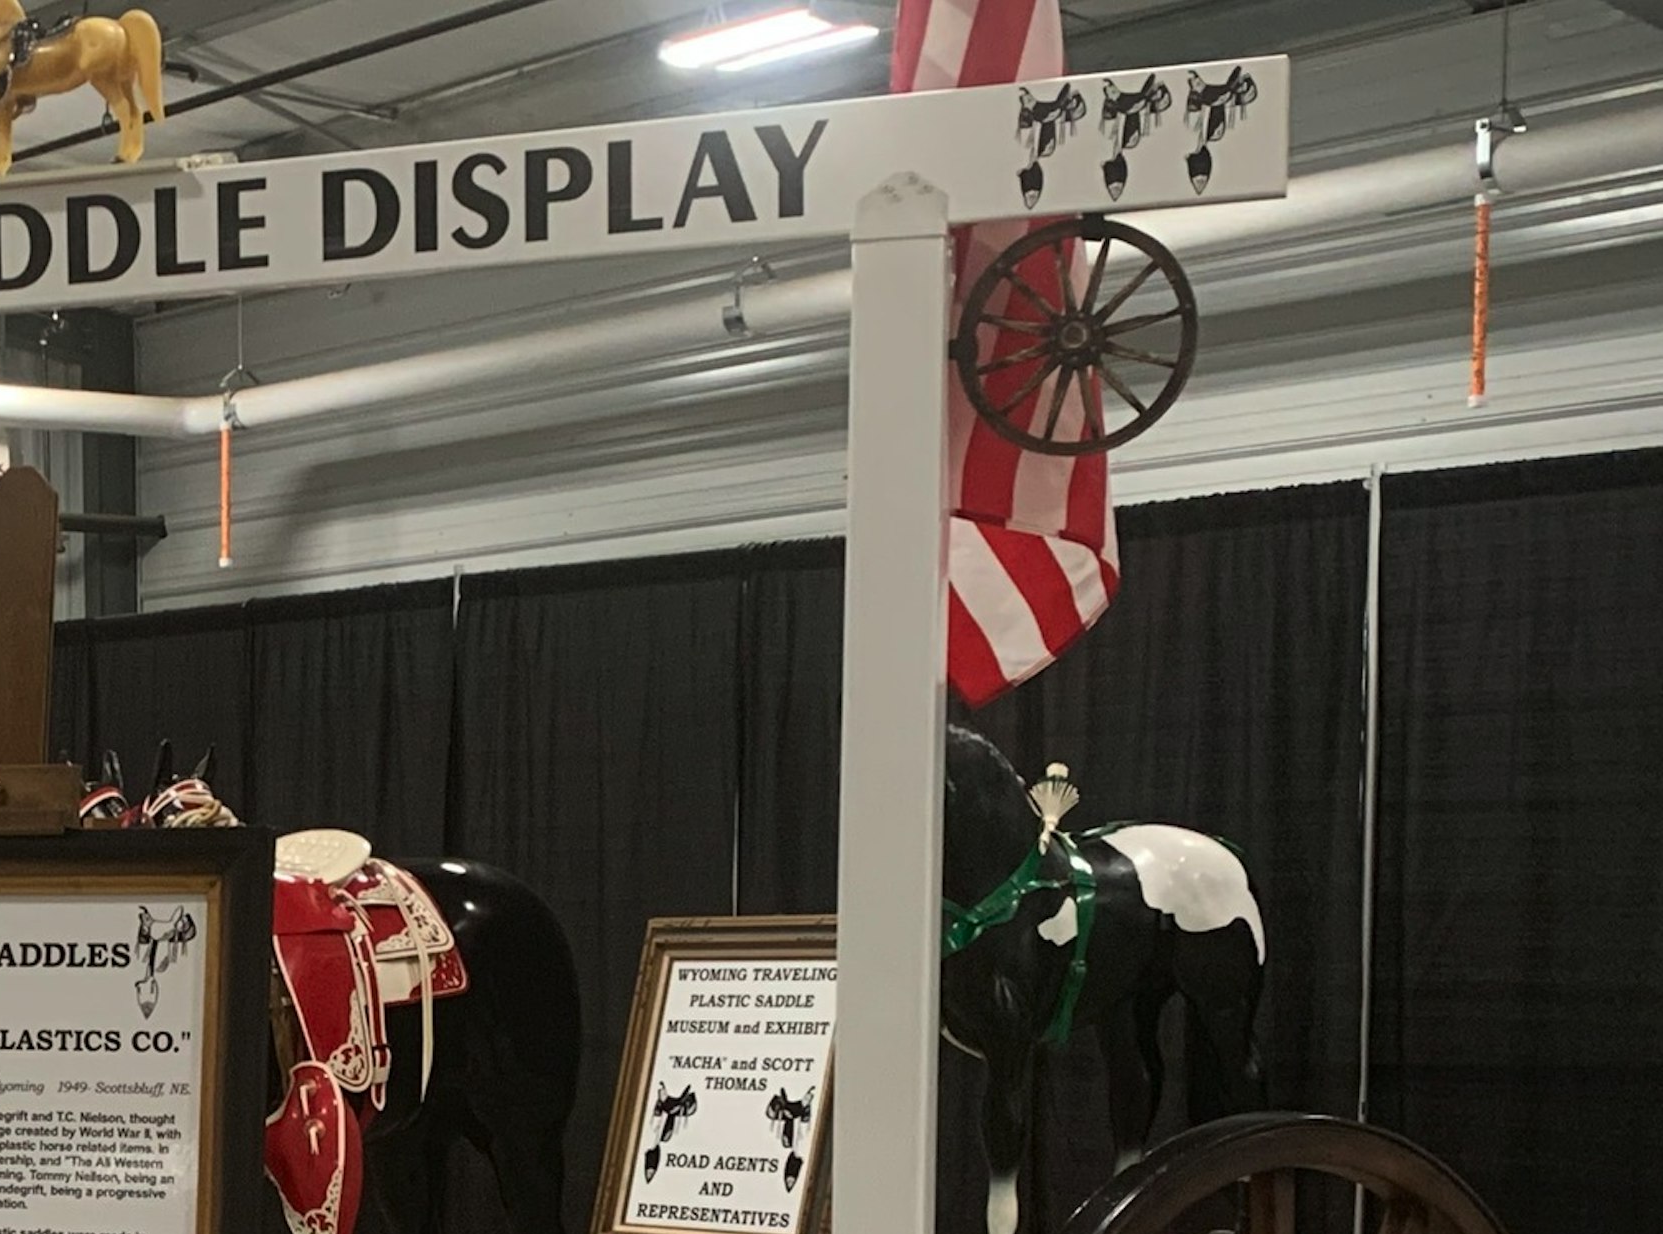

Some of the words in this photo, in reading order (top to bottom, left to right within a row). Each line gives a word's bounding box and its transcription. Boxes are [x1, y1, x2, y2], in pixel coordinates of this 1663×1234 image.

[322, 118, 828, 263] DISPLAY
[678, 968, 748, 982] WYOMING
[752, 968, 838, 982] TRAVELING
[689, 994, 751, 1008] PLASTIC
[754, 994, 815, 1008] SADDLE
[666, 1020, 730, 1033] MUSEUM
[734, 1021, 760, 1034] and
[764, 1021, 830, 1035] EXHIBIT
[131, 1030, 191, 1053] CO."
[669, 1055, 727, 1070] "NACHA"
[731, 1057, 757, 1071] and
[761, 1058, 814, 1072] SCOTT
[705, 1077, 768, 1091] THOMAS
[30, 1110, 54, 1123] and
[128, 1112, 176, 1128] thought
[666, 1153, 710, 1169] ROAD
[713, 1155, 779, 1173] AGENTS
[699, 1182, 733, 1197] AND
[637, 1204, 790, 1228] REPRESENTATIVES
